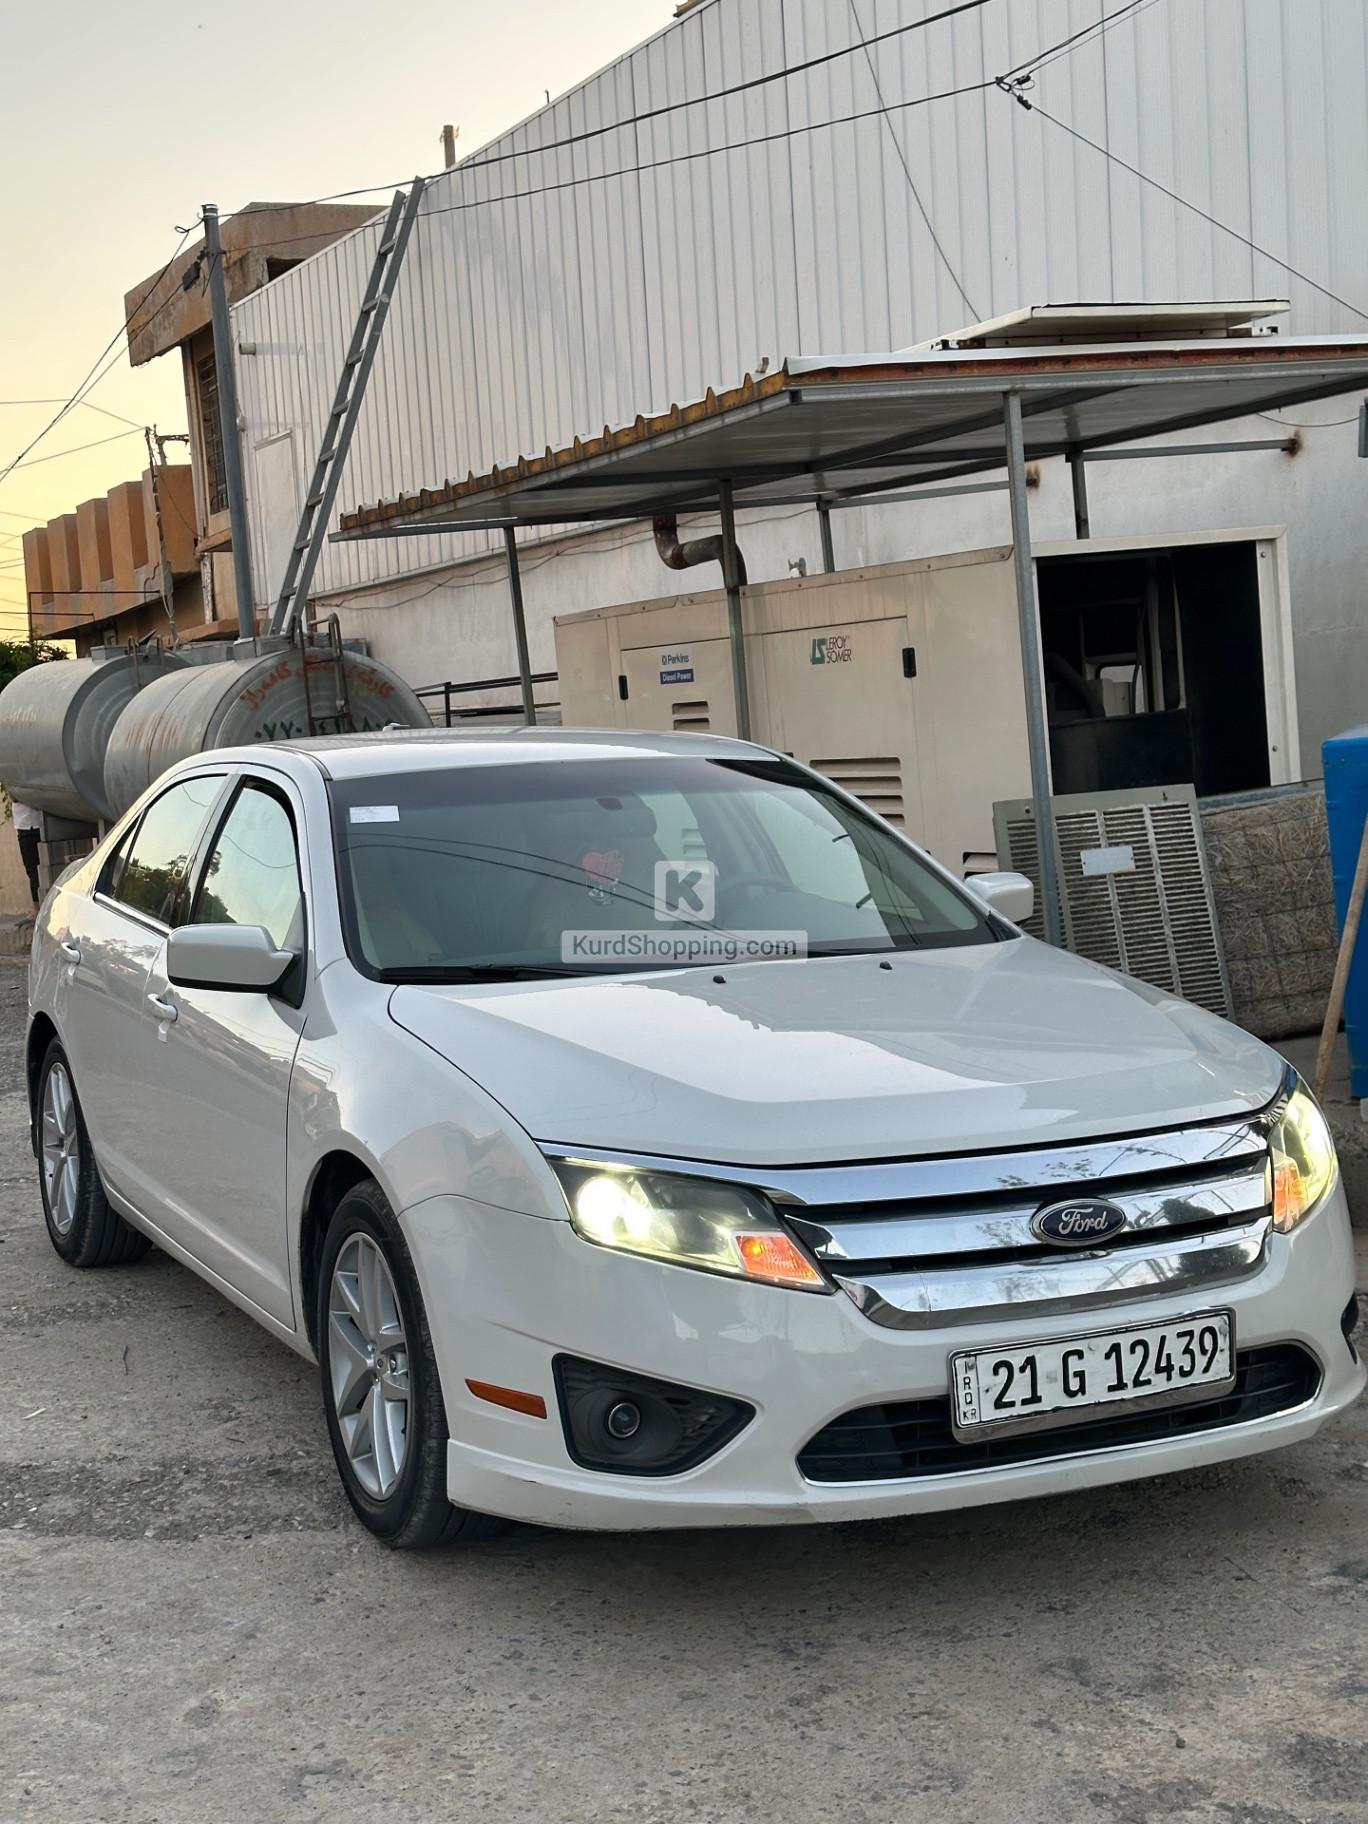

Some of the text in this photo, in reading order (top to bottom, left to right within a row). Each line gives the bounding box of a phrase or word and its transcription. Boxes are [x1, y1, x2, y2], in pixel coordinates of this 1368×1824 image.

[826, 635, 848, 650] LEROY
[667, 653, 690, 665] Perkins
[826, 648, 852, 664] SOMER
[662, 671, 692, 682] Diesel Power
[1058, 1207, 1109, 1235] Ford
[992, 1325, 1220, 1410] 21 G 12439
[962, 1408, 977, 1421] KR
